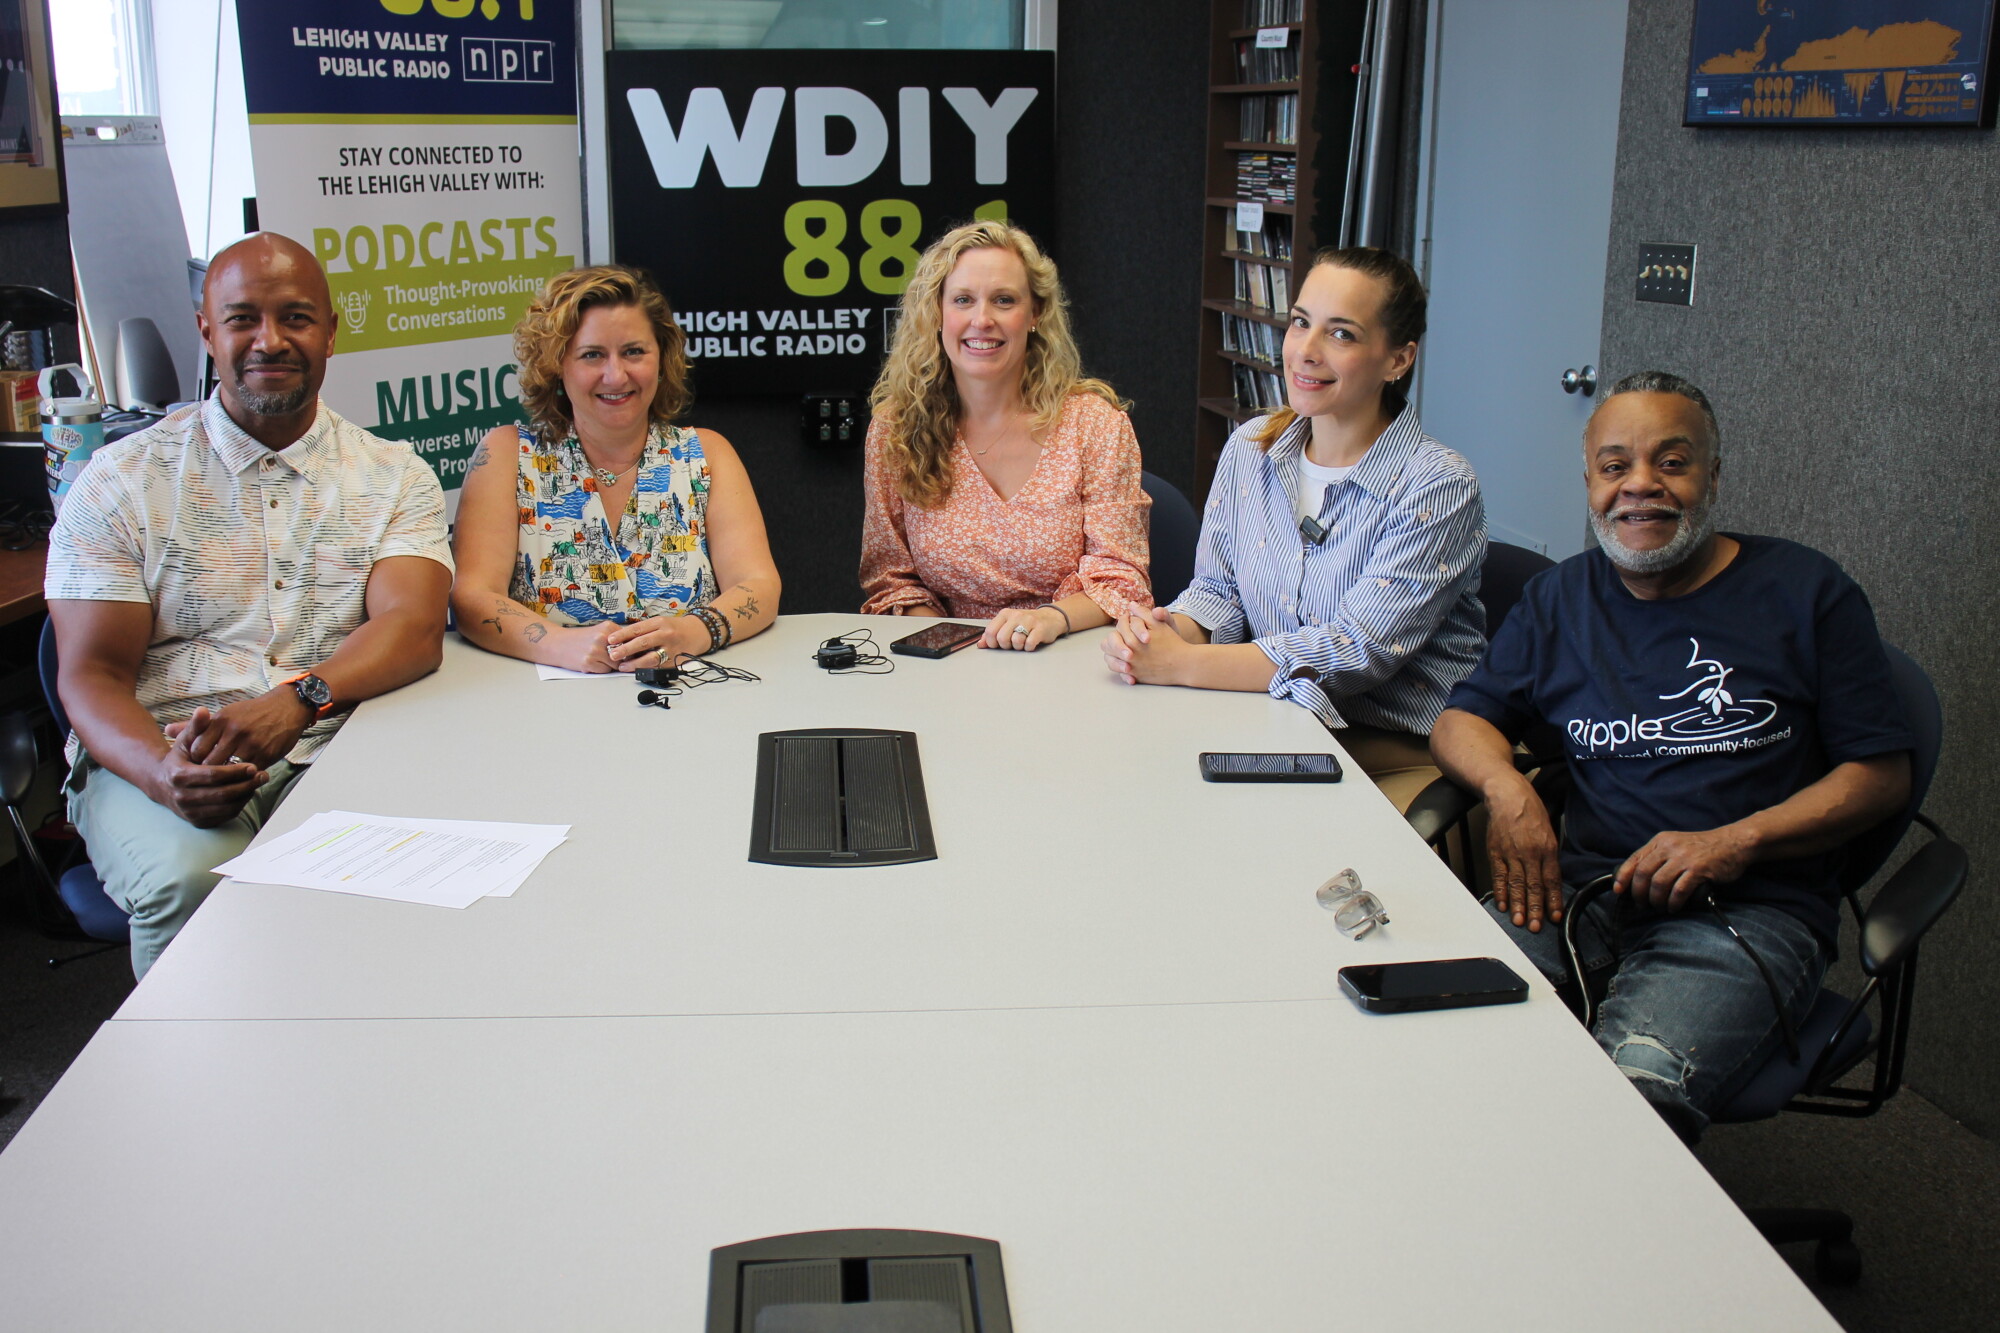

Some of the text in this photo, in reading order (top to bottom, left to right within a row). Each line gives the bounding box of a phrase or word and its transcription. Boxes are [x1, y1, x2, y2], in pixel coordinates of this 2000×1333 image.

[292, 27, 449, 52] LEHIGH VALLEY
[319, 56, 450, 79] PUBLIC RADIO
[469, 47, 544, 80] npr
[626, 86, 1039, 189] WDIY
[339, 146, 522, 167] STAY CONNECTED TO
[318, 171, 545, 196] THE LEHIGH VALLEY WITH:
[313, 216, 558, 273] PODCASTS
[384, 275, 544, 306] Thought-Provoking
[386, 305, 506, 332] Conversations
[672, 310, 749, 333] HIGH
[757, 308, 871, 331] VALLEY
[683, 333, 867, 358] UBLIC RADIO
[376, 363, 519, 427] MUSIC
[410, 433, 461, 454] iverse
[1567, 713, 1663, 752] Ripple
[1658, 726, 1791, 756] Community-focused
